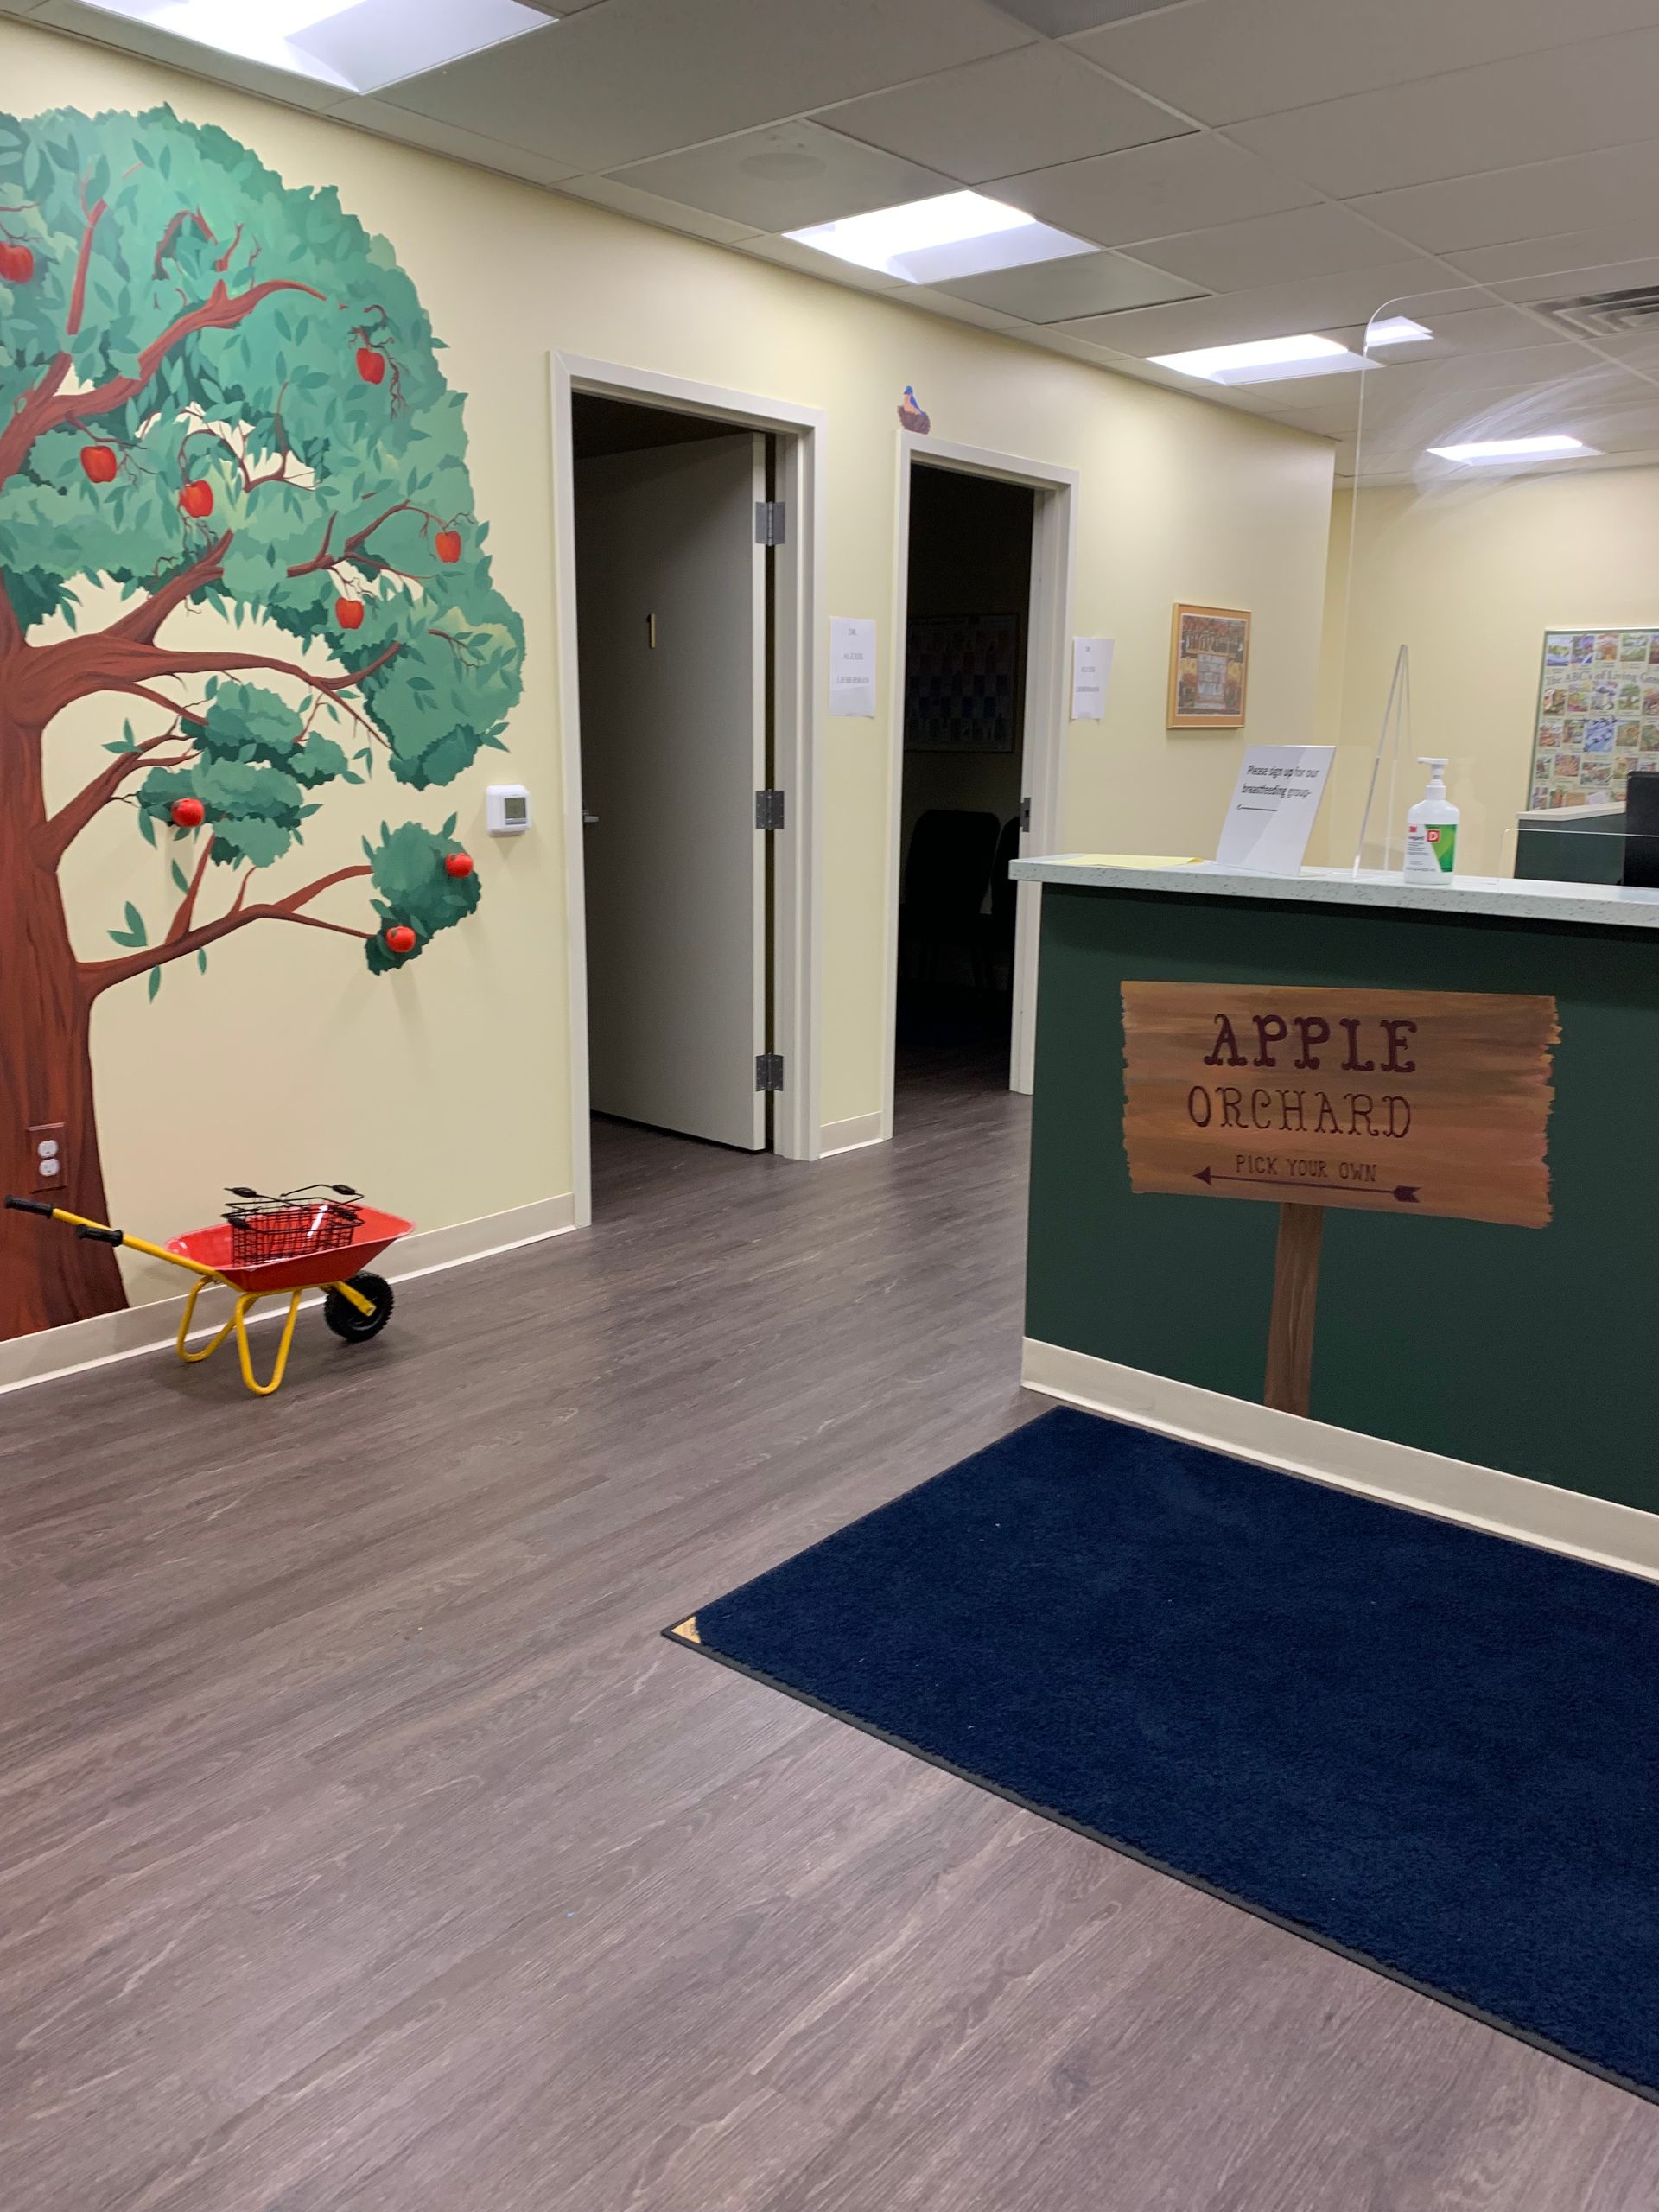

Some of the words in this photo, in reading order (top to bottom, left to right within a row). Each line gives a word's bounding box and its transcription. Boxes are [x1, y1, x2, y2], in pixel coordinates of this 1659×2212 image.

[1247, 765, 1268, 776] Please
[1268, 766, 1283, 779] sign
[1283, 768, 1294, 779] up
[1294, 766, 1306, 778] for
[1306, 769, 1320, 778] our
[1242, 782, 1287, 798] breastfeeding
[1204, 1013, 1418, 1073] APPLE
[1188, 1085, 1412, 1139] ORCHARD
[1236, 1154, 1278, 1175] PICK
[1287, 1158, 1328, 1179] YOUR
[1339, 1161, 1378, 1183] OWN
